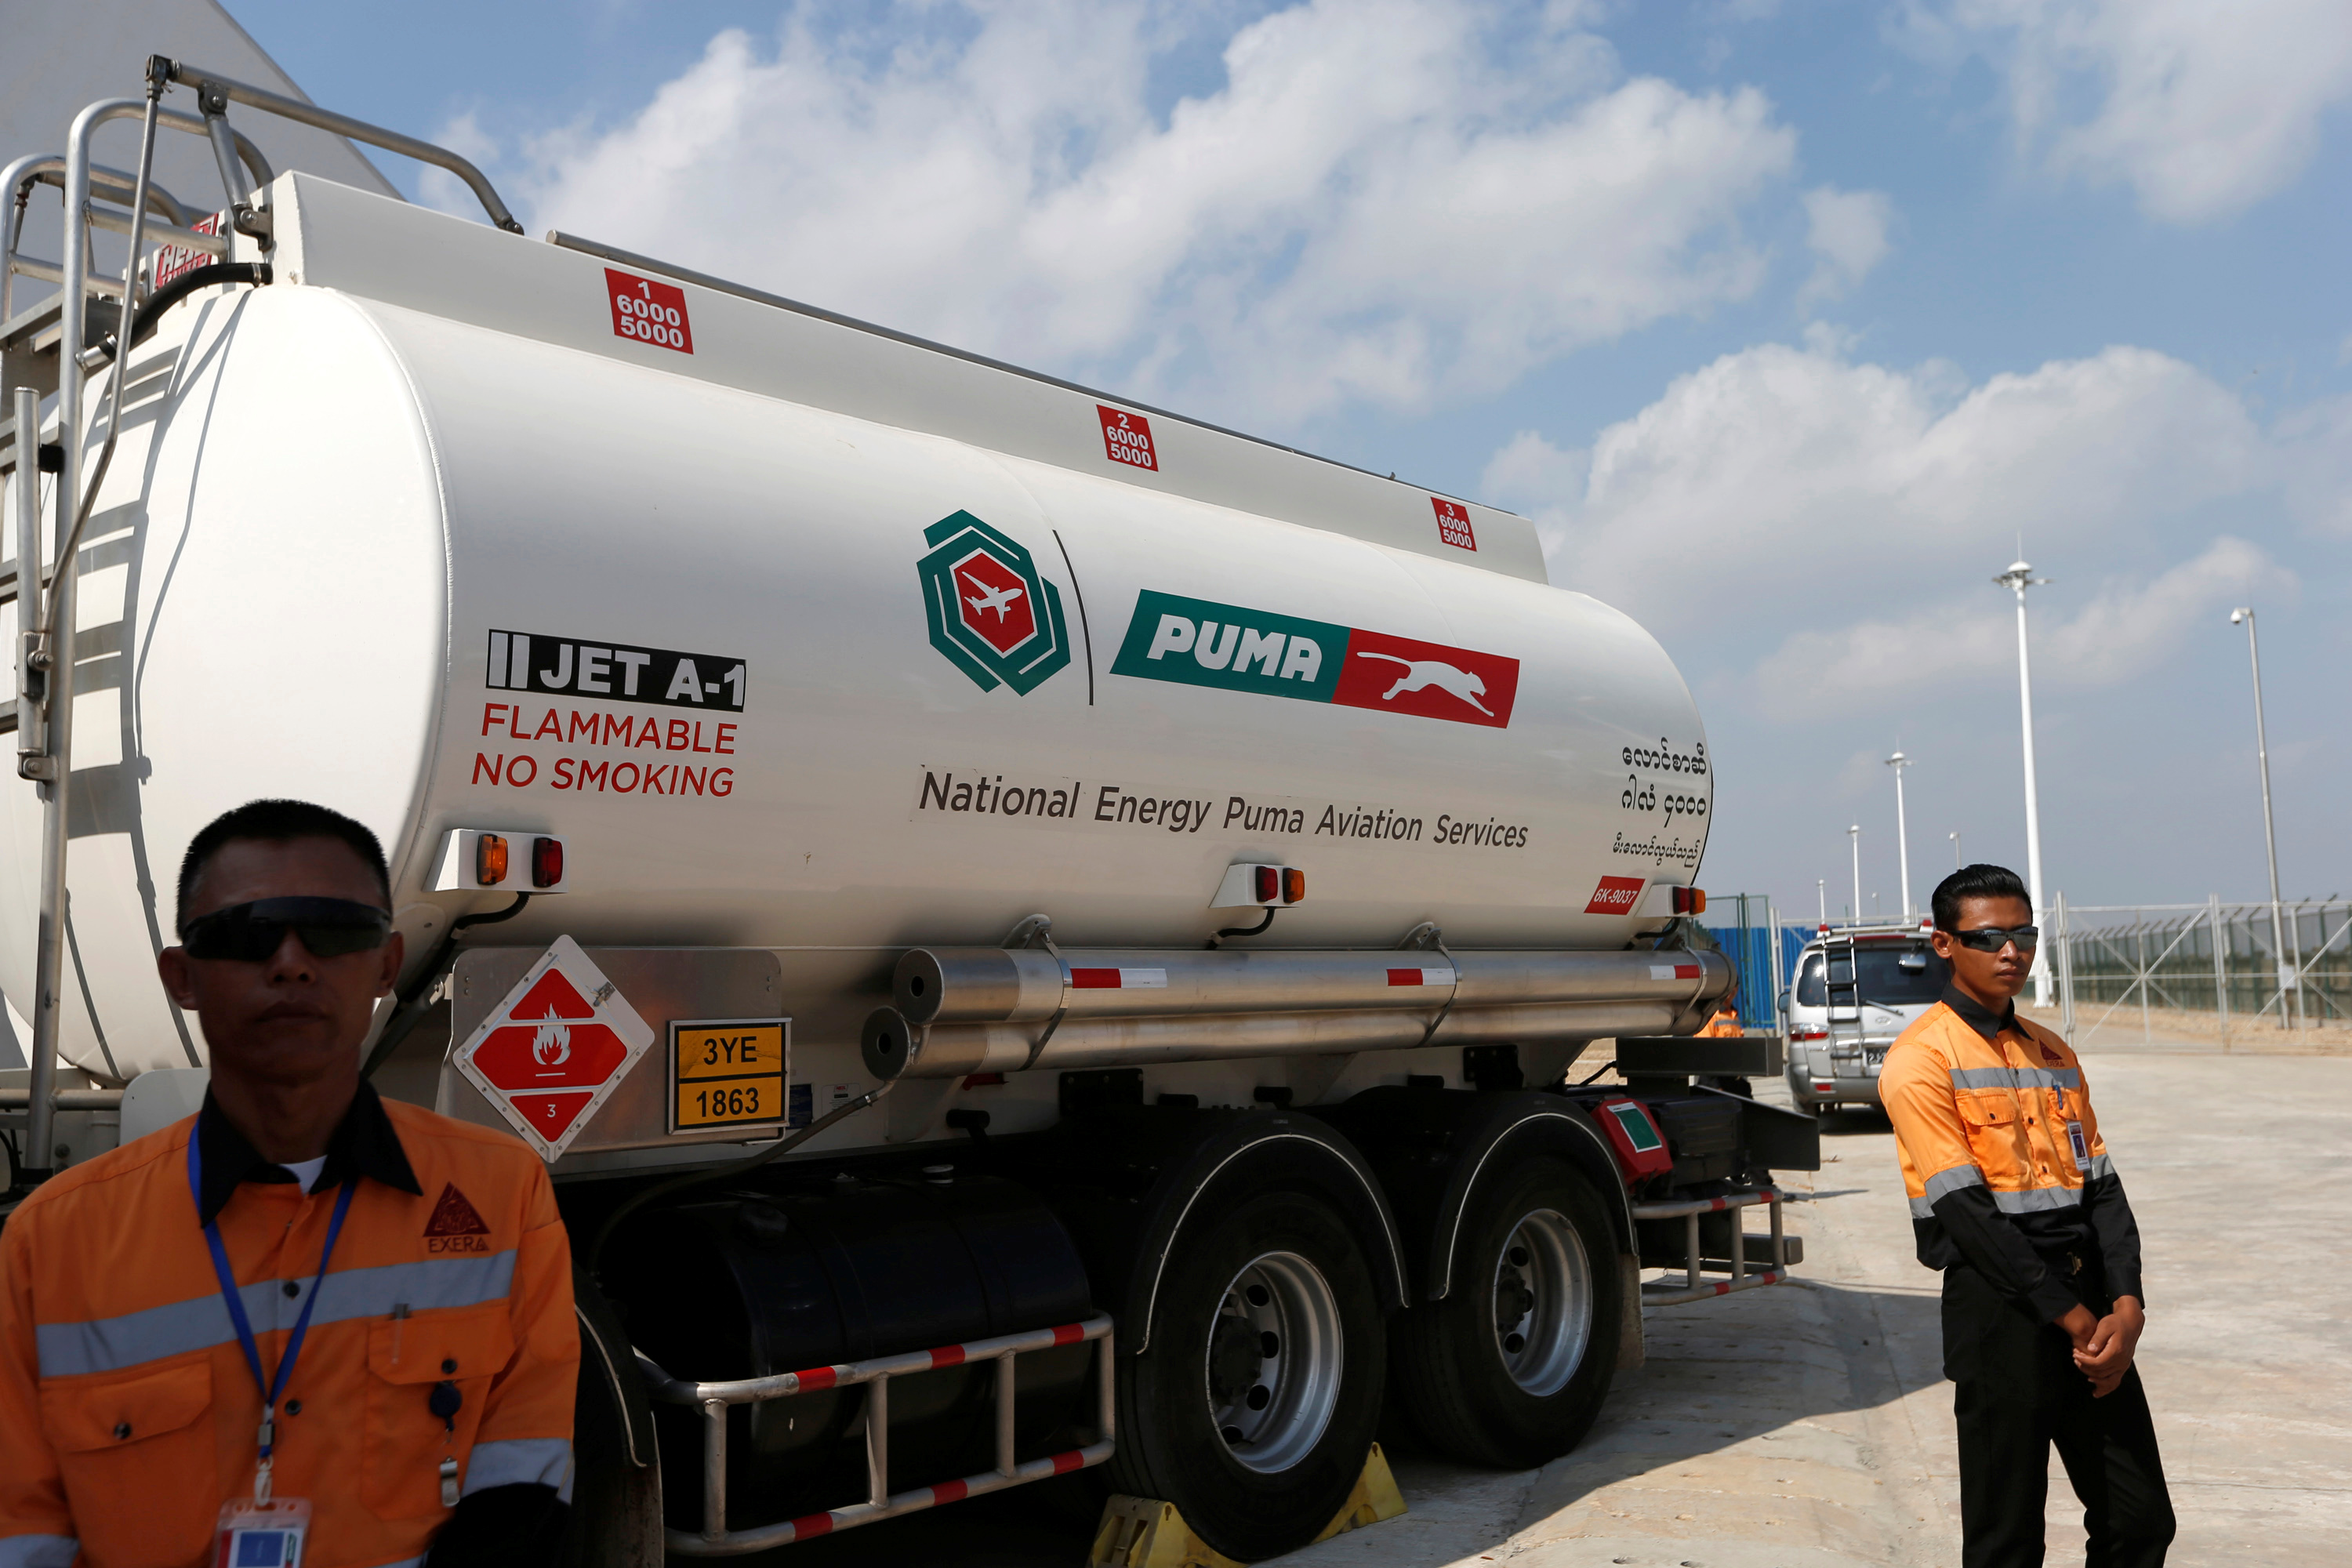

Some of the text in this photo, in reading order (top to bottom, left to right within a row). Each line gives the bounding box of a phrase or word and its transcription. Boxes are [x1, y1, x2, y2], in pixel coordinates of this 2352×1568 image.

[637, 281, 651, 299] 1
[616, 294, 681, 327] 6000
[620, 315, 684, 348] 5000
[1117, 413, 1130, 429] 2
[1106, 426, 1149, 449] 6000
[1110, 442, 1152, 466] 5000
[1445, 503, 1454, 517] 3
[1439, 514, 1468, 534] 6000
[1443, 528, 1472, 548] 5000
[1146, 613, 1323, 682] PUMA
[539, 643, 745, 706] JET A-1
[481, 702, 738, 755] FLAMMABLE
[471, 753, 735, 797] NO SMOKING
[919, 771, 1529, 848] National Energy Puma Aviation Services
[1593, 887, 1638, 905] 6K-9037
[702, 1036, 758, 1065] 3YE
[547, 1104, 556, 1118] 3
[696, 1087, 760, 1118] 1863
[429, 1236, 490, 1254] EXERA
